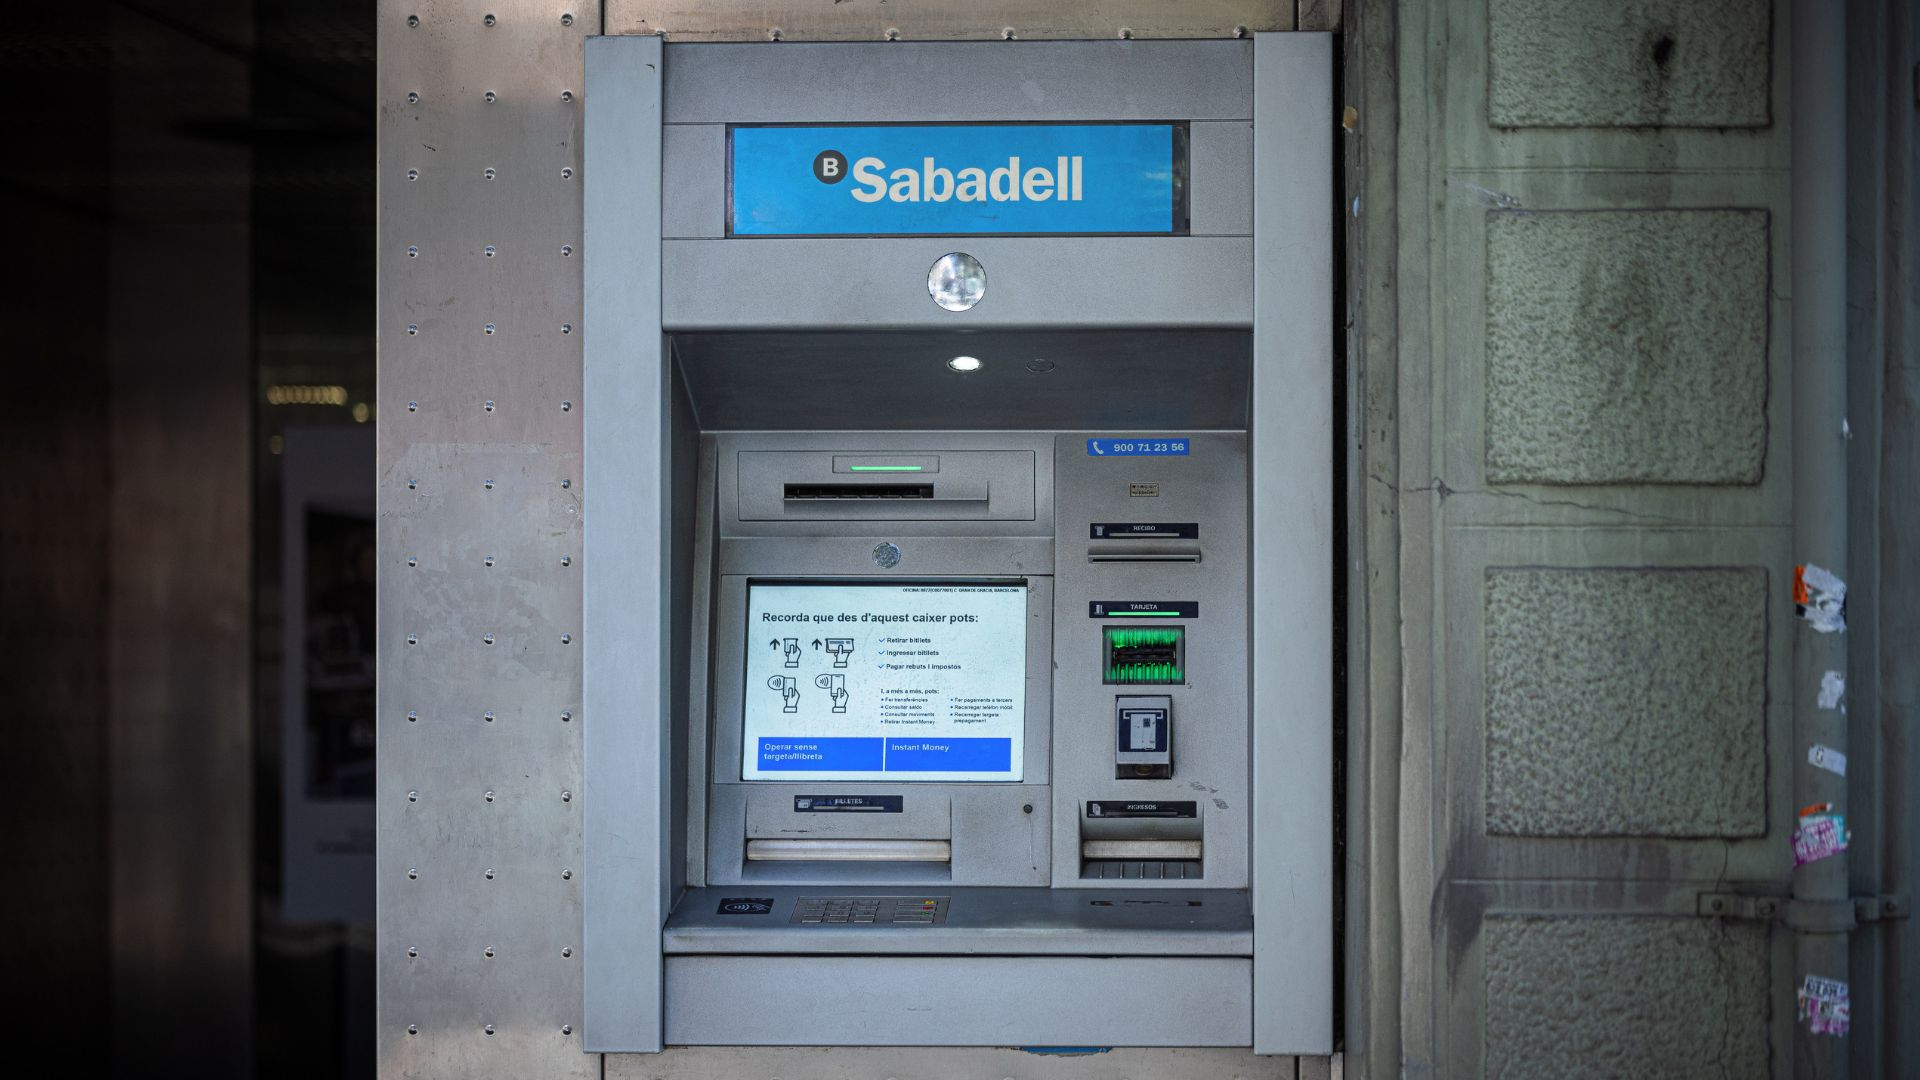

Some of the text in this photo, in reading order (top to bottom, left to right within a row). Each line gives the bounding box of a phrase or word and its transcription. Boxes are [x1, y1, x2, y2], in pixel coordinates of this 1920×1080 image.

[822, 156, 1083, 203] B Sabadell
[1113, 443, 1185, 452] 900 71 23 56
[762, 612, 979, 624] Recorda que des d'aquest caixer pots:
[764, 743, 791, 752] Operar
[892, 743, 950, 752] Instant Money
[764, 752, 823, 761] targeta/llibreta
